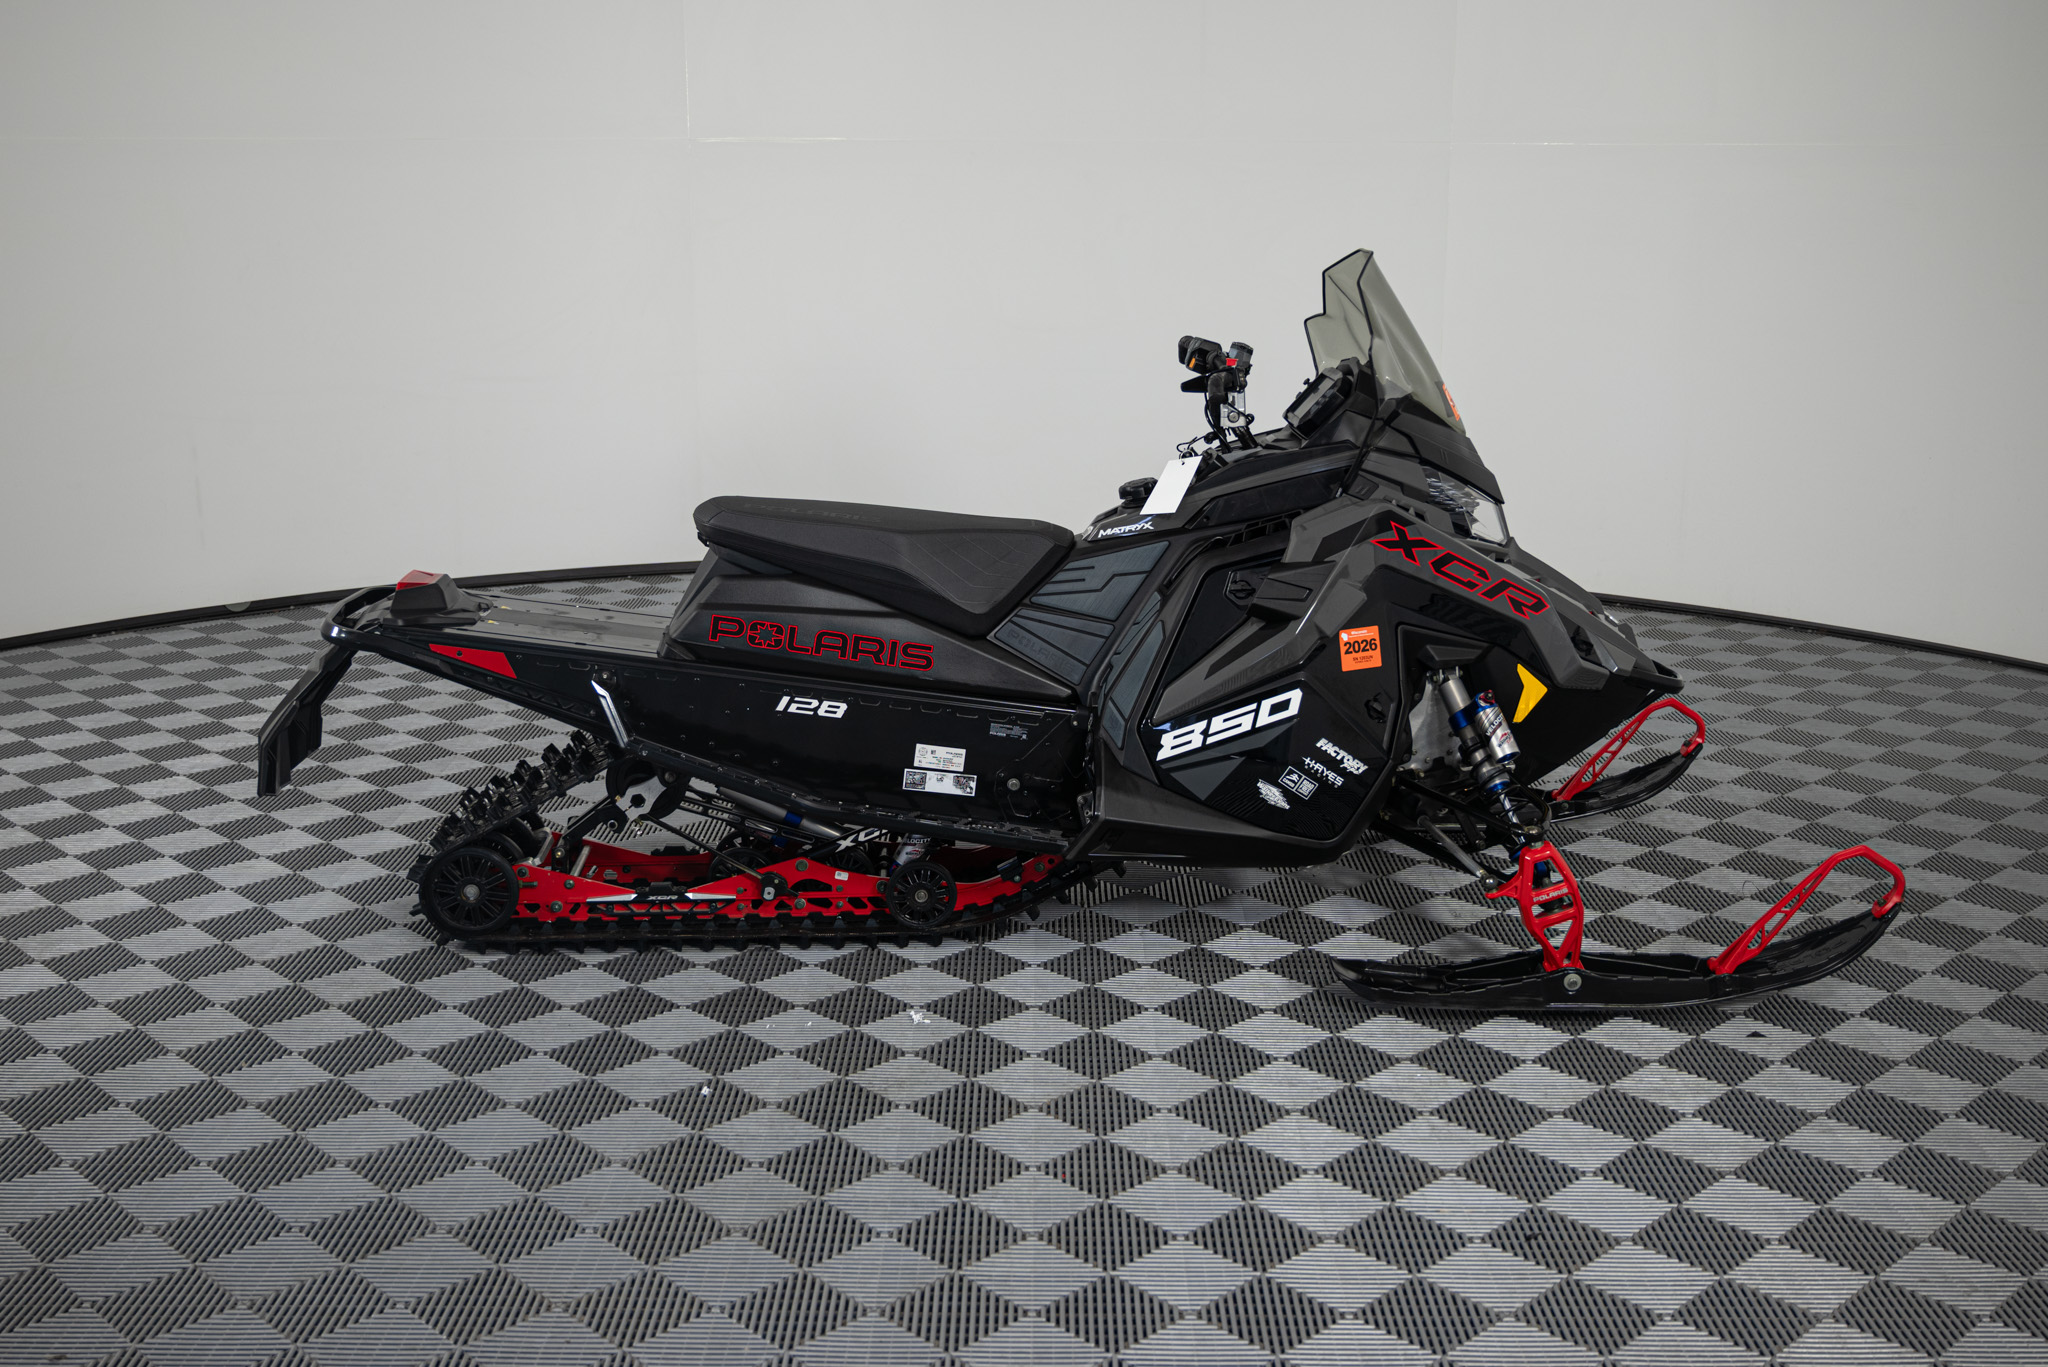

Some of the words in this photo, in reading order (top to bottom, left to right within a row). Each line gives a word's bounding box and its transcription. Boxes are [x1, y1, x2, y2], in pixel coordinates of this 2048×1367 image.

[1098, 521, 1154, 538] MATRYX
[1370, 520, 1550, 620] XCR
[709, 614, 934, 671] POLARIS
[1343, 638, 1378, 655] 2026
[775, 695, 848, 719] 128
[1156, 688, 1303, 762] 850
[1485, 713, 1503, 737] VELOCI
[1316, 738, 1368, 774] FACTORY
[1302, 757, 1345, 786] HAYES
[835, 827, 888, 853] XC
[1533, 887, 1569, 902] POLARIS
